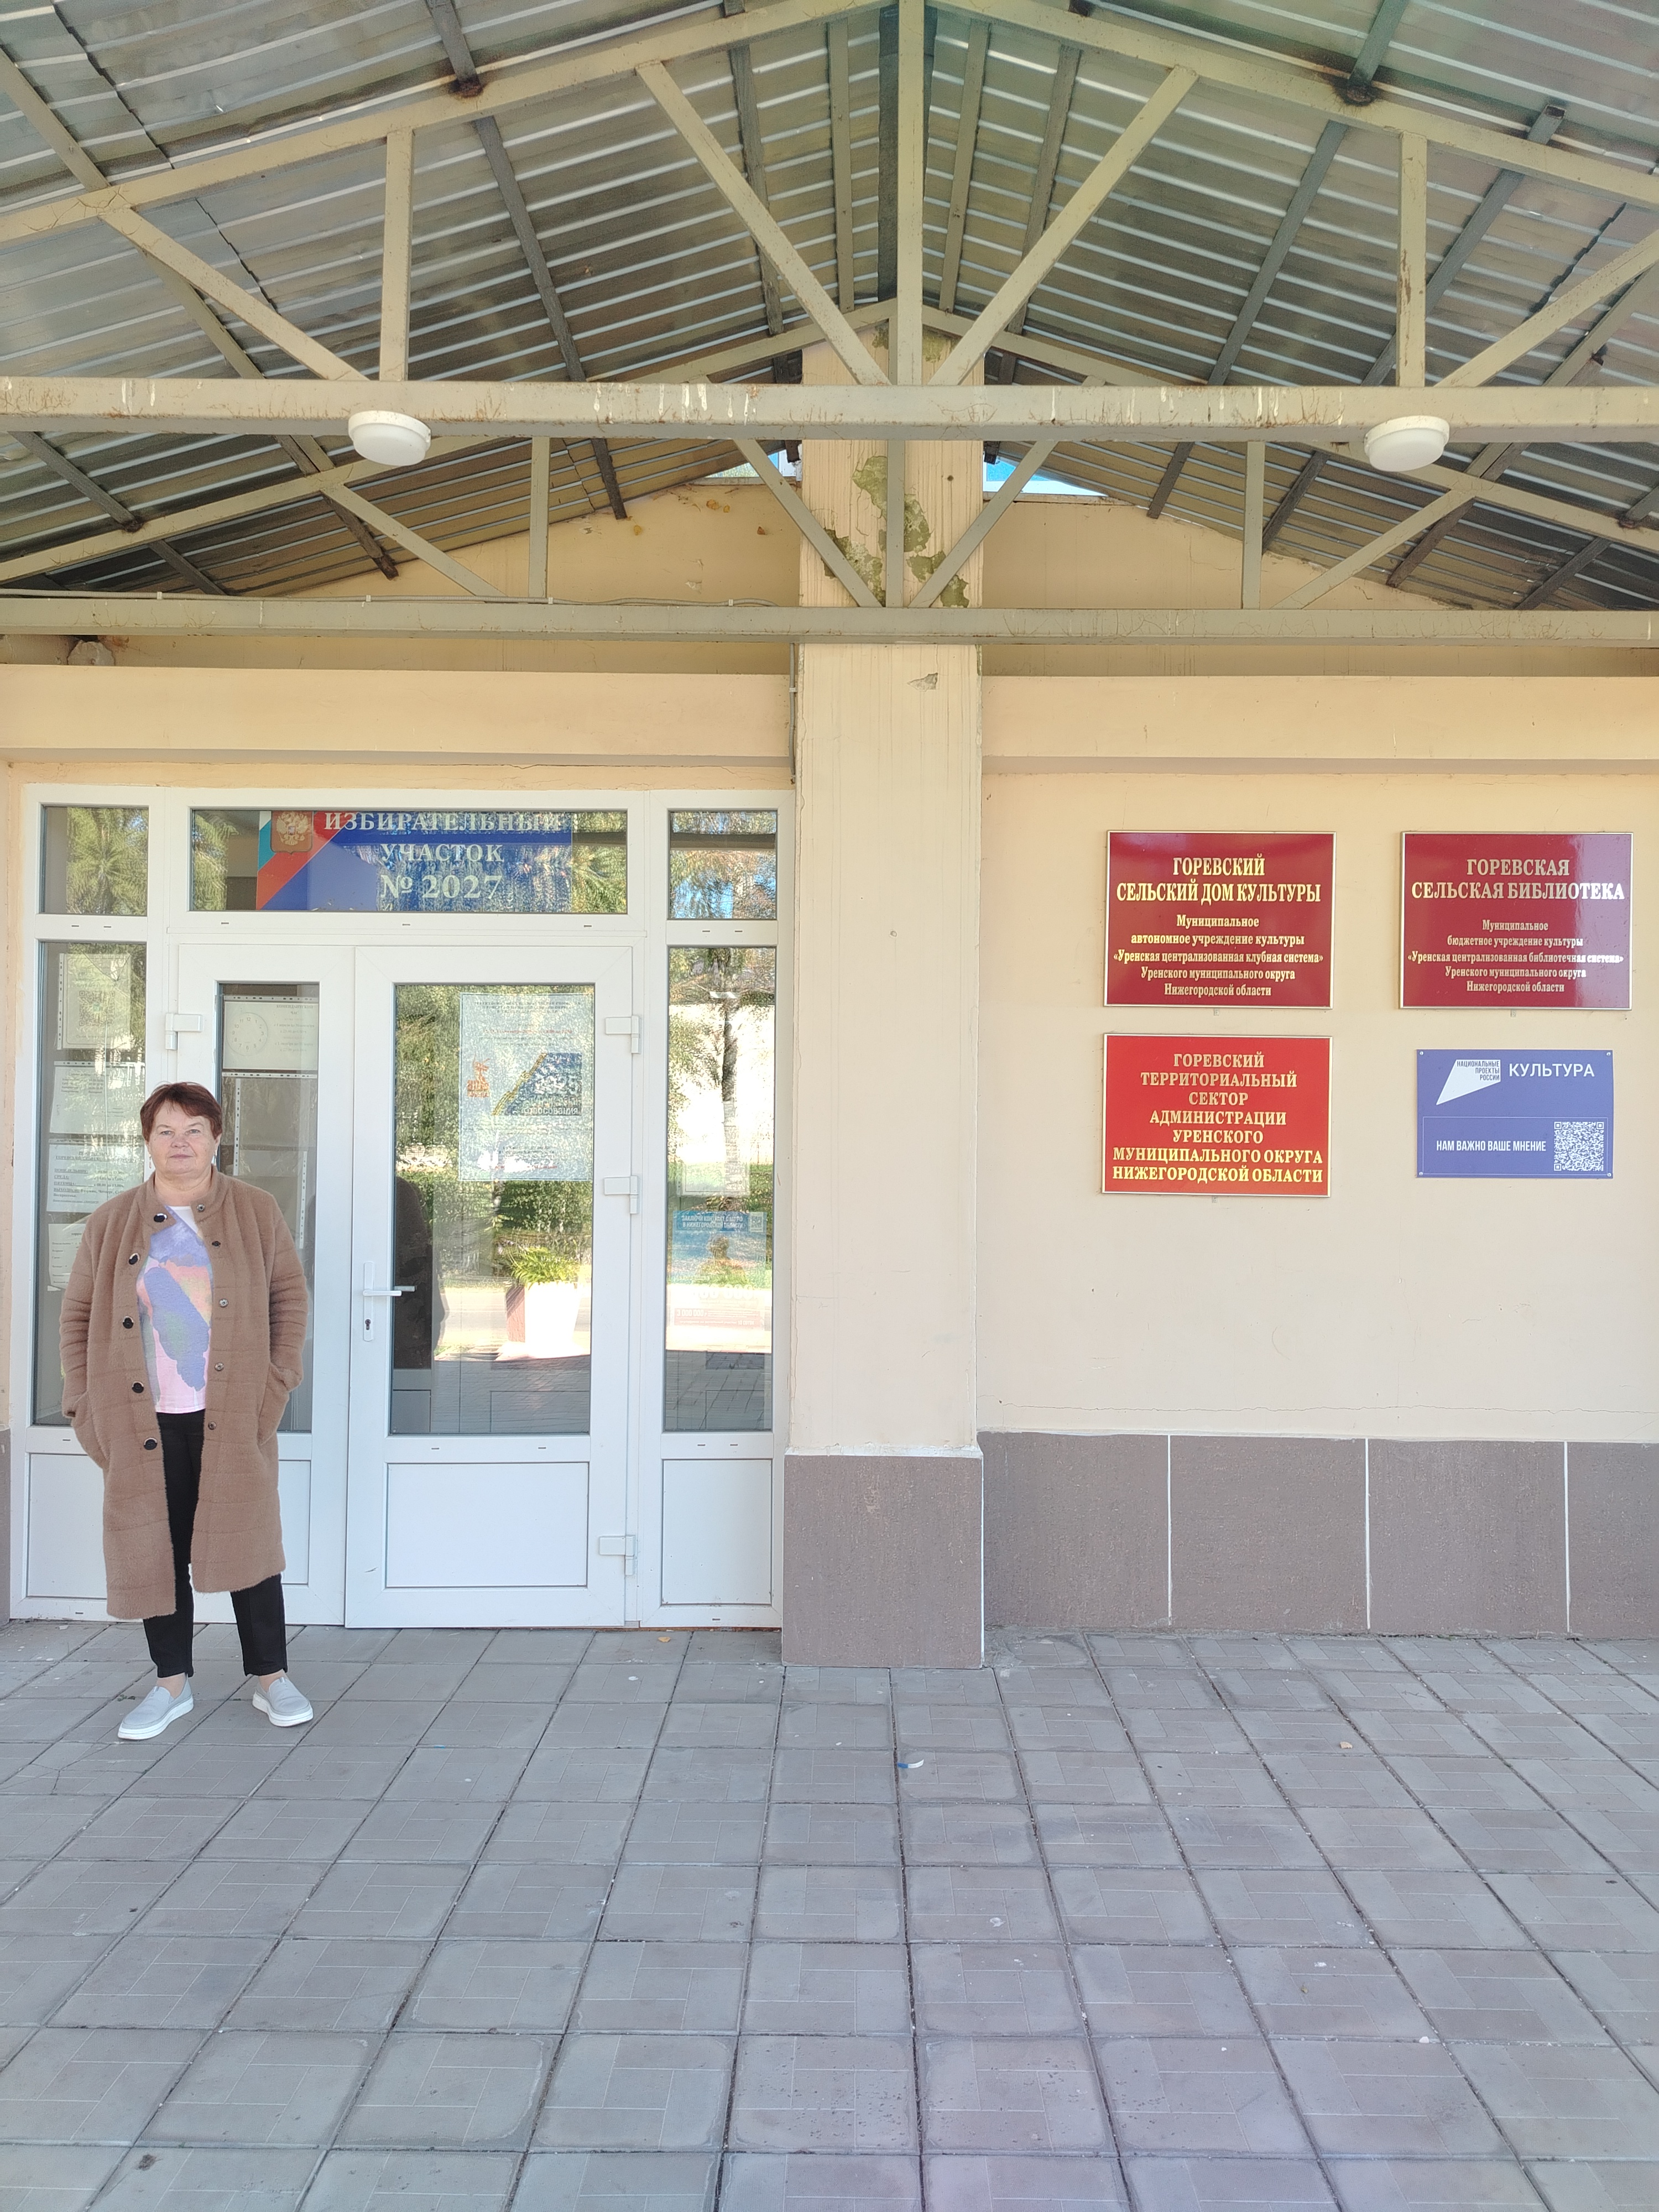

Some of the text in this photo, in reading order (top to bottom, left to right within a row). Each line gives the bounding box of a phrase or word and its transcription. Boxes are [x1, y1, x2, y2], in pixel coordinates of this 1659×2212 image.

[380, 843, 504, 862] УЧАСТОК
[1173, 854, 1265, 875] ГОРЕВСКИЙ
[1467, 859, 1569, 875] ГОРЕВСКАЯ
[380, 875, 503, 899] № 2027
[1117, 879, 1321, 905] СЕЛЬСКИЙ ДОМ КУЛЬТУРЫ
[1411, 883, 1625, 900] СЕЛЬСКАЯ БИБЛИОТЕКА
[1177, 915, 1259, 929] Муниципальное
[1483, 920, 1548, 932] Муниципальное
[1131, 935, 1305, 947] автономное учреждение культуры
[1447, 936, 1583, 948] бюджетное учреждение культуры
[1114, 950, 1323, 964] «Уренская централизованная клубная система»
[1408, 951, 1451, 964] «Уренская
[1452, 954, 1527, 963] централизованная
[1529, 953, 1586, 963] библиотечная
[1141, 967, 1295, 982] Уренского муниципального округа
[1445, 966, 1586, 979] Уренского муниципального округа
[1165, 983, 1271, 998] Нижегородской области
[1467, 981, 1564, 993] Нижегородской области
[1174, 1051, 1264, 1067] ГОРЕВСКИЙ
[1509, 1063, 1594, 1077] КУЛЬТУРА
[1141, 1071, 1297, 1087] ТЕРРИТОРИАЛЬНЫЙ
[1189, 1092, 1248, 1105] СЕКТОР
[1150, 1110, 1286, 1127] АДМИНИСТРАЦИИ
[1173, 1130, 1263, 1144] УРЕНСКОГО
[1437, 1140, 1546, 1151] НАМ ВАЖНО ВАШЕ МНЕНИЕ
[1113, 1147, 1323, 1164] МУНИЦИПАЛЬНОГО ОКРУГА
[1113, 1165, 1323, 1183] НИЖЕГОРОДСКОЙ ОБЛАСТИ
